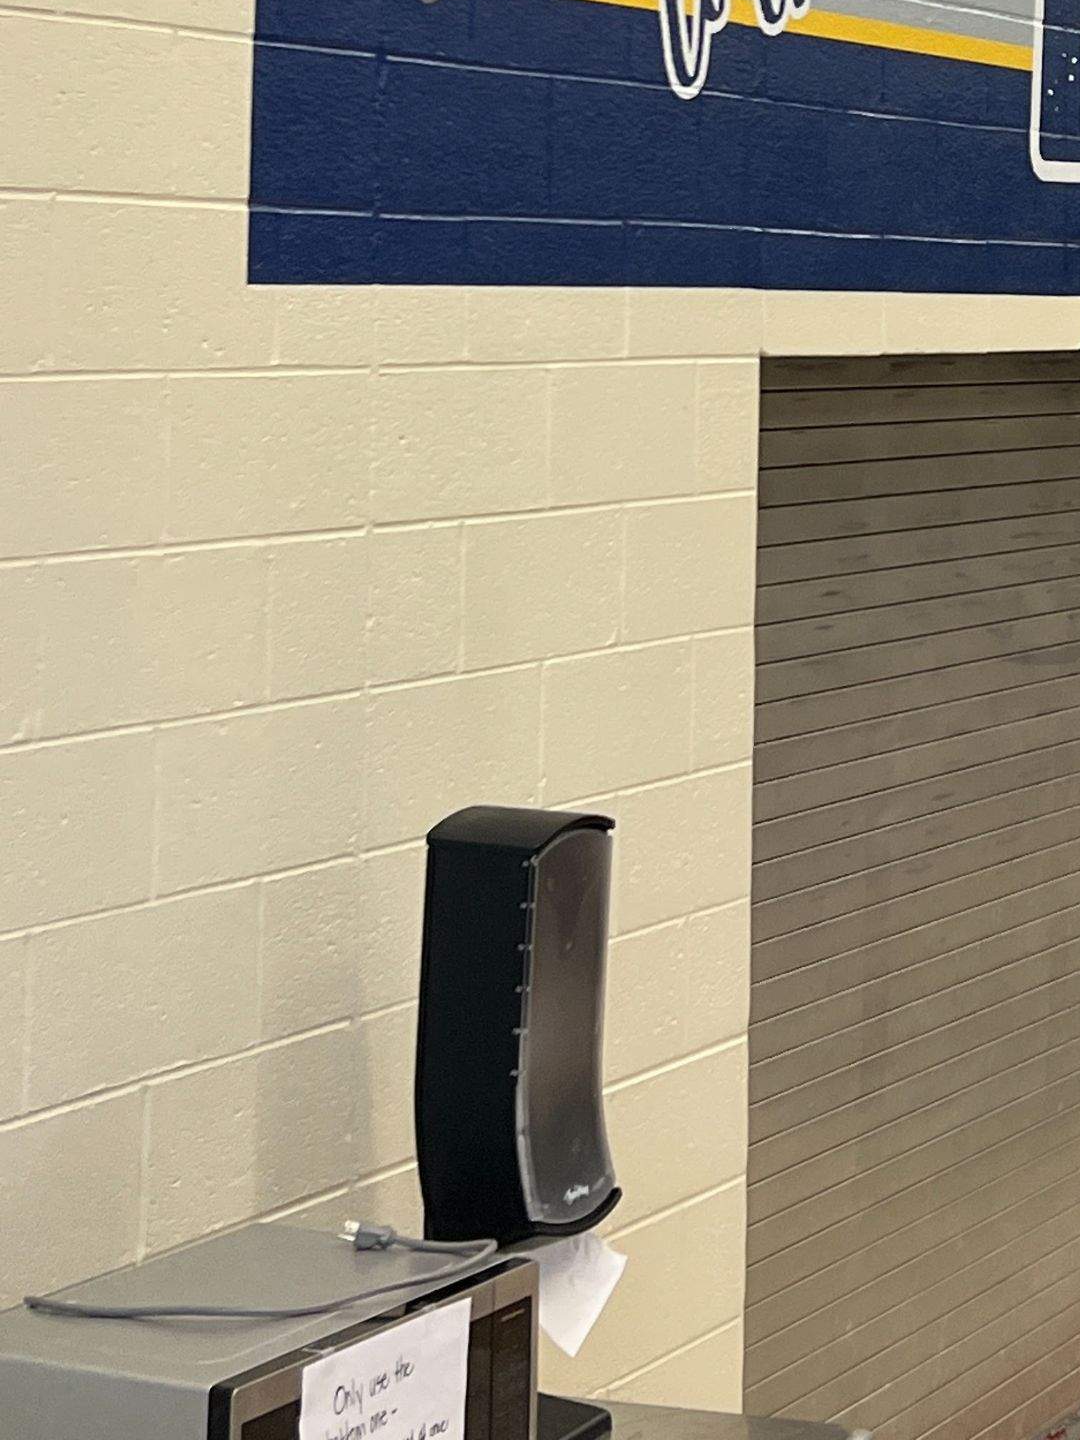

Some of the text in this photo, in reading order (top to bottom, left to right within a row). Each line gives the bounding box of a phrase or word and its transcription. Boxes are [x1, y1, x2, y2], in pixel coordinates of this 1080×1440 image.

[333, 1355, 414, 1415] Only use the
